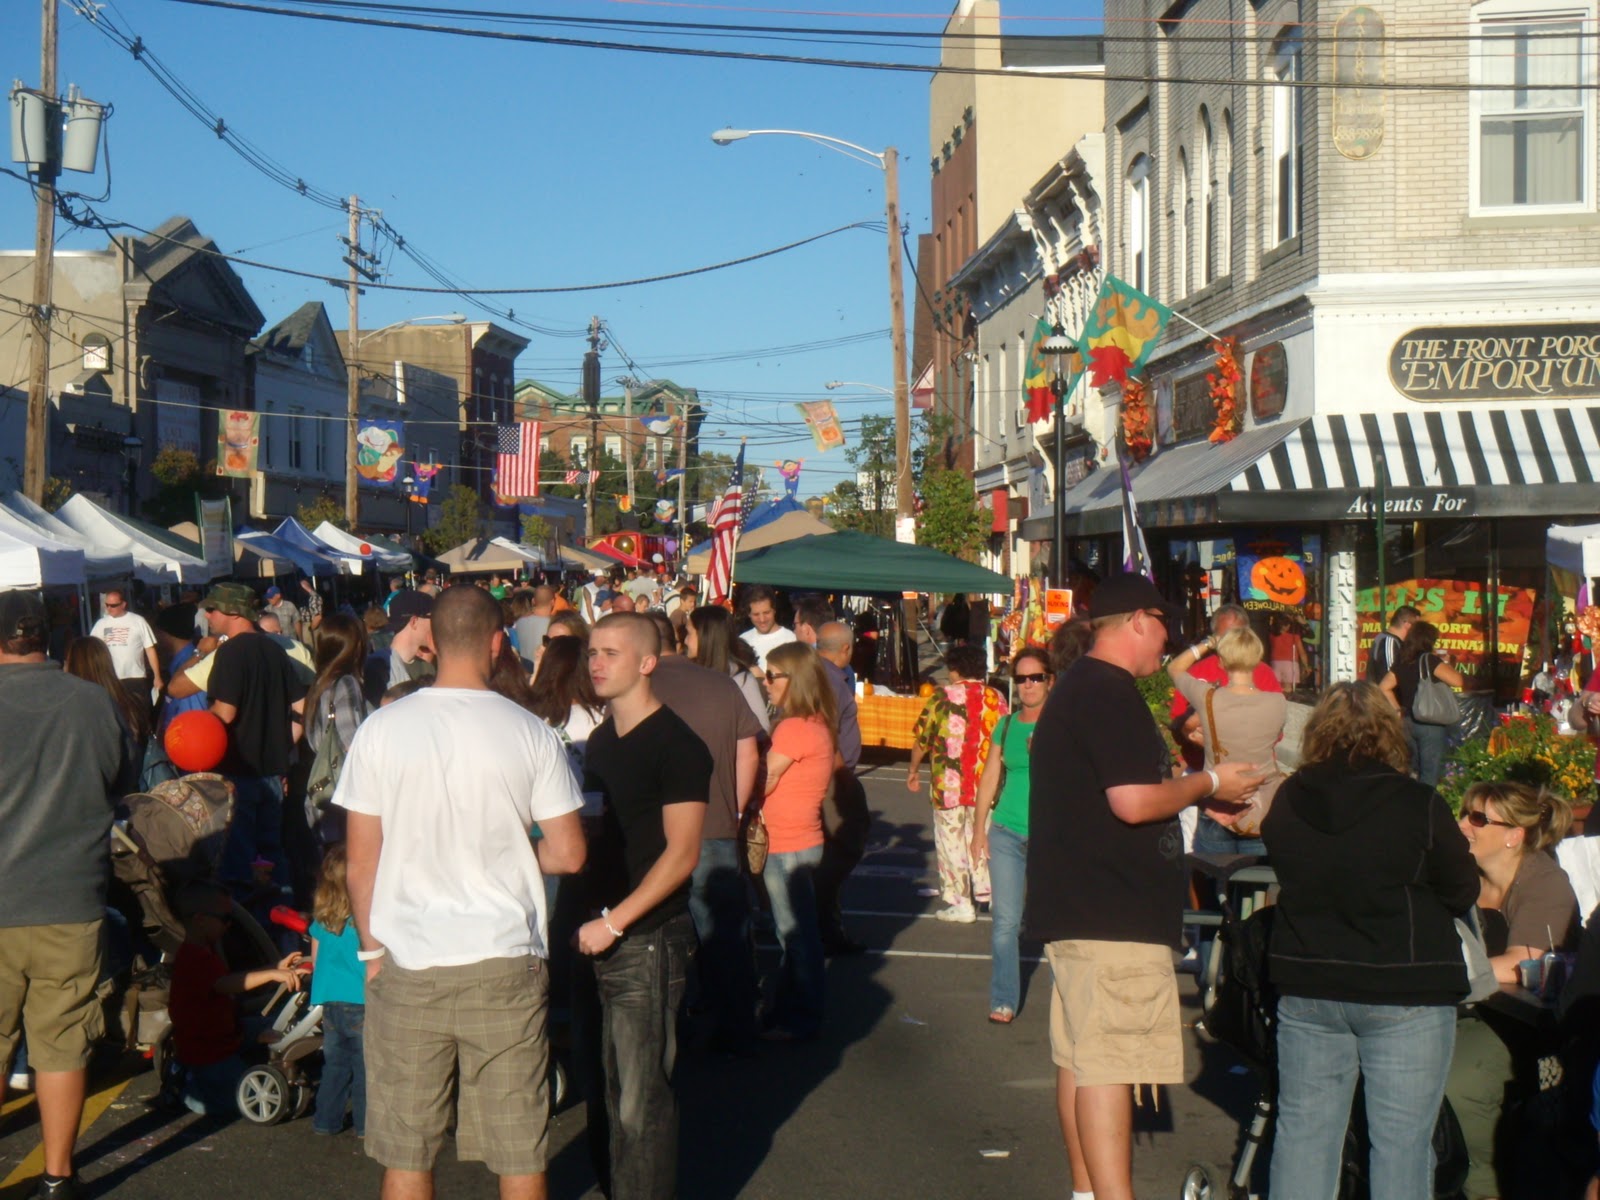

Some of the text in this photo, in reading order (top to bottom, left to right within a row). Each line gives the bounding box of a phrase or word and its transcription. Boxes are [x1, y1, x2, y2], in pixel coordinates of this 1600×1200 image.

[1400, 335, 1600, 361] THE FRONT PORC
[1432, 493, 1467, 511] For
[1356, 587, 1445, 612] ALL'S
[1336, 552, 1355, 682] URNITUR
[1433, 638, 1520, 654] STINATON
